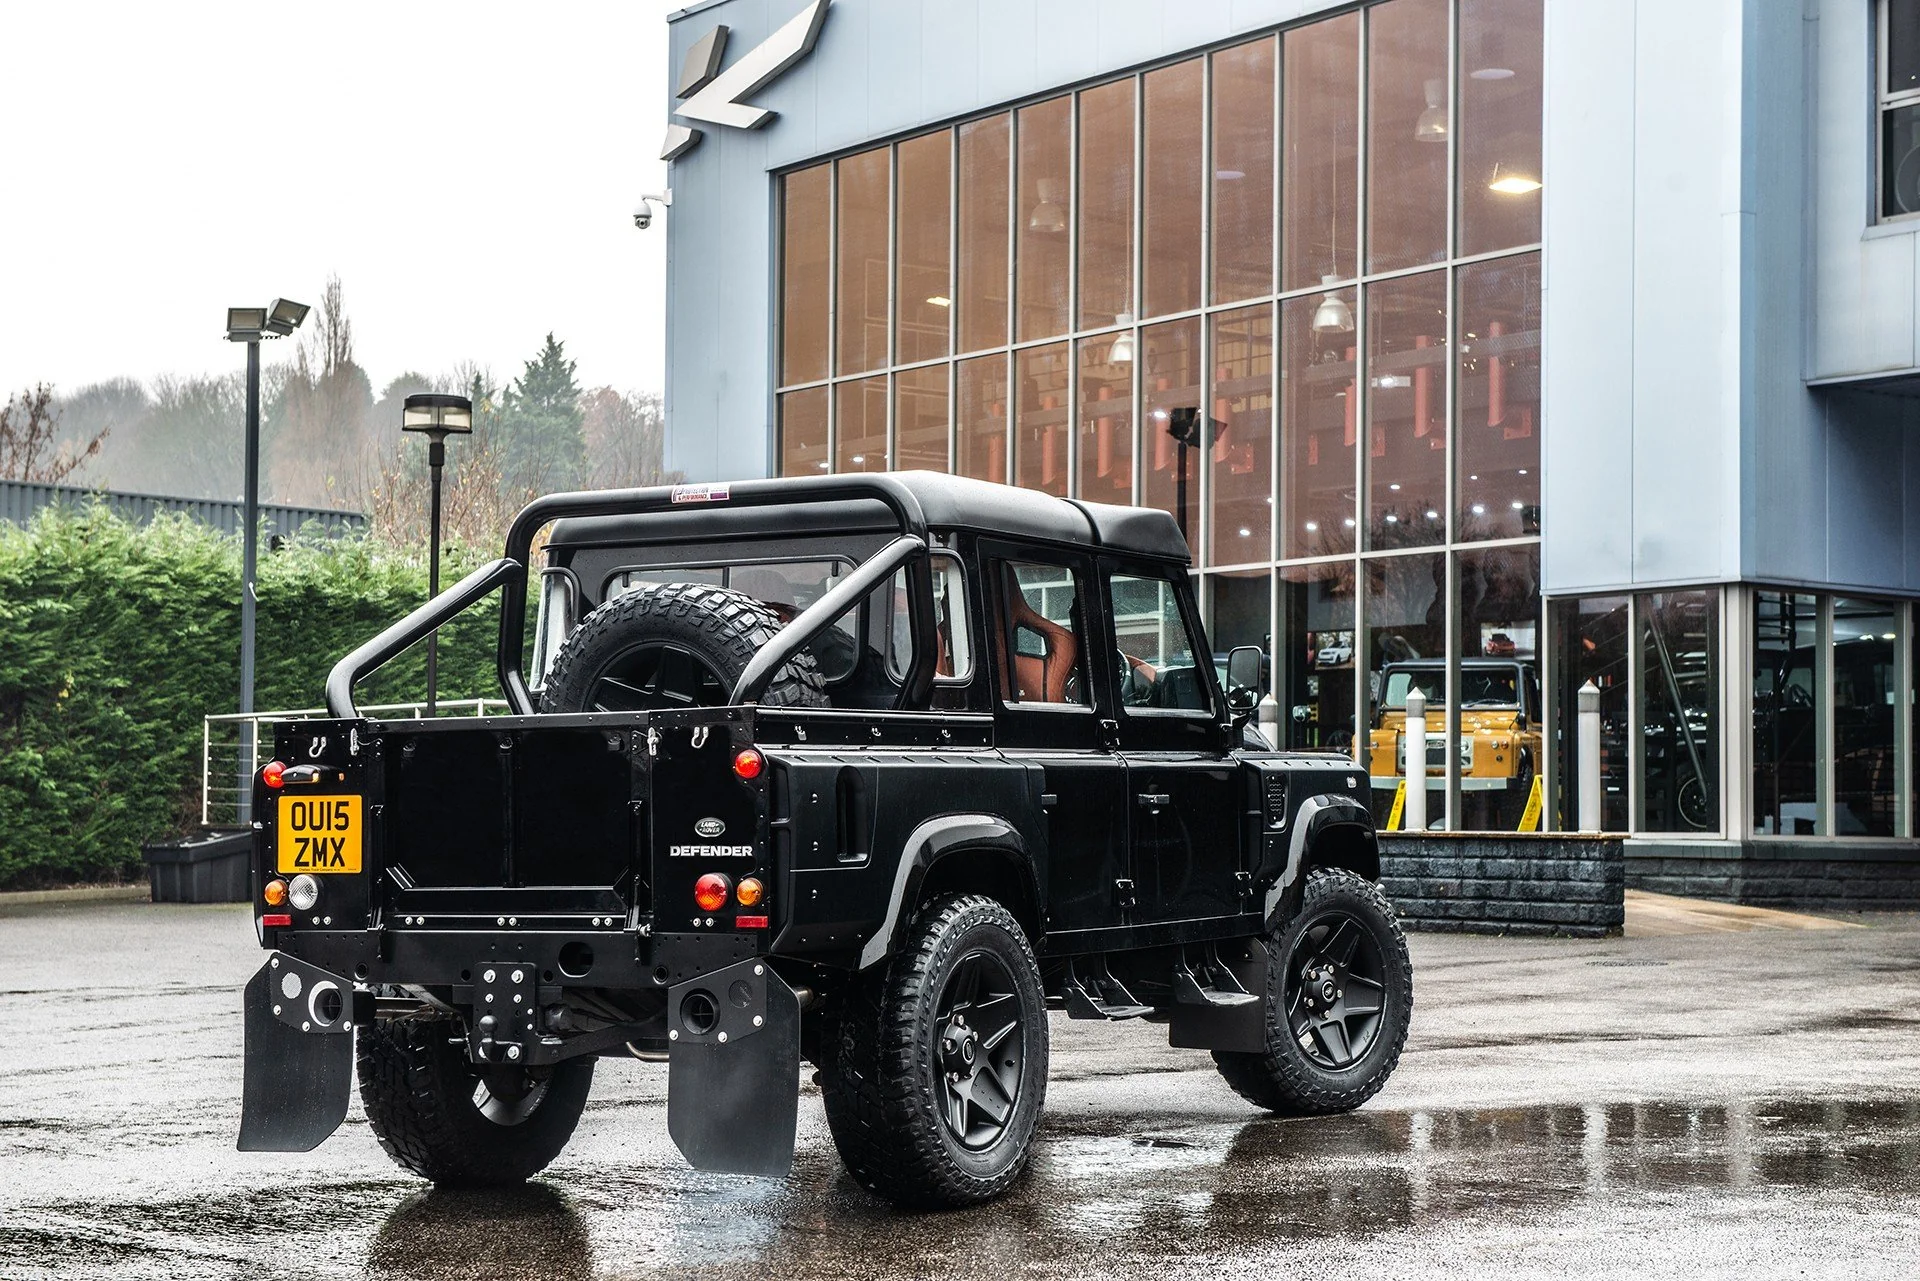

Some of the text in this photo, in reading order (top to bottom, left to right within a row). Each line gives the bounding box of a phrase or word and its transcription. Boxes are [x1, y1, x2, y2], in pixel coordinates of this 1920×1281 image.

[291, 801, 349, 831] OU15
[295, 837, 346, 867] ZMX
[669, 845, 753, 857] DEFENDER
